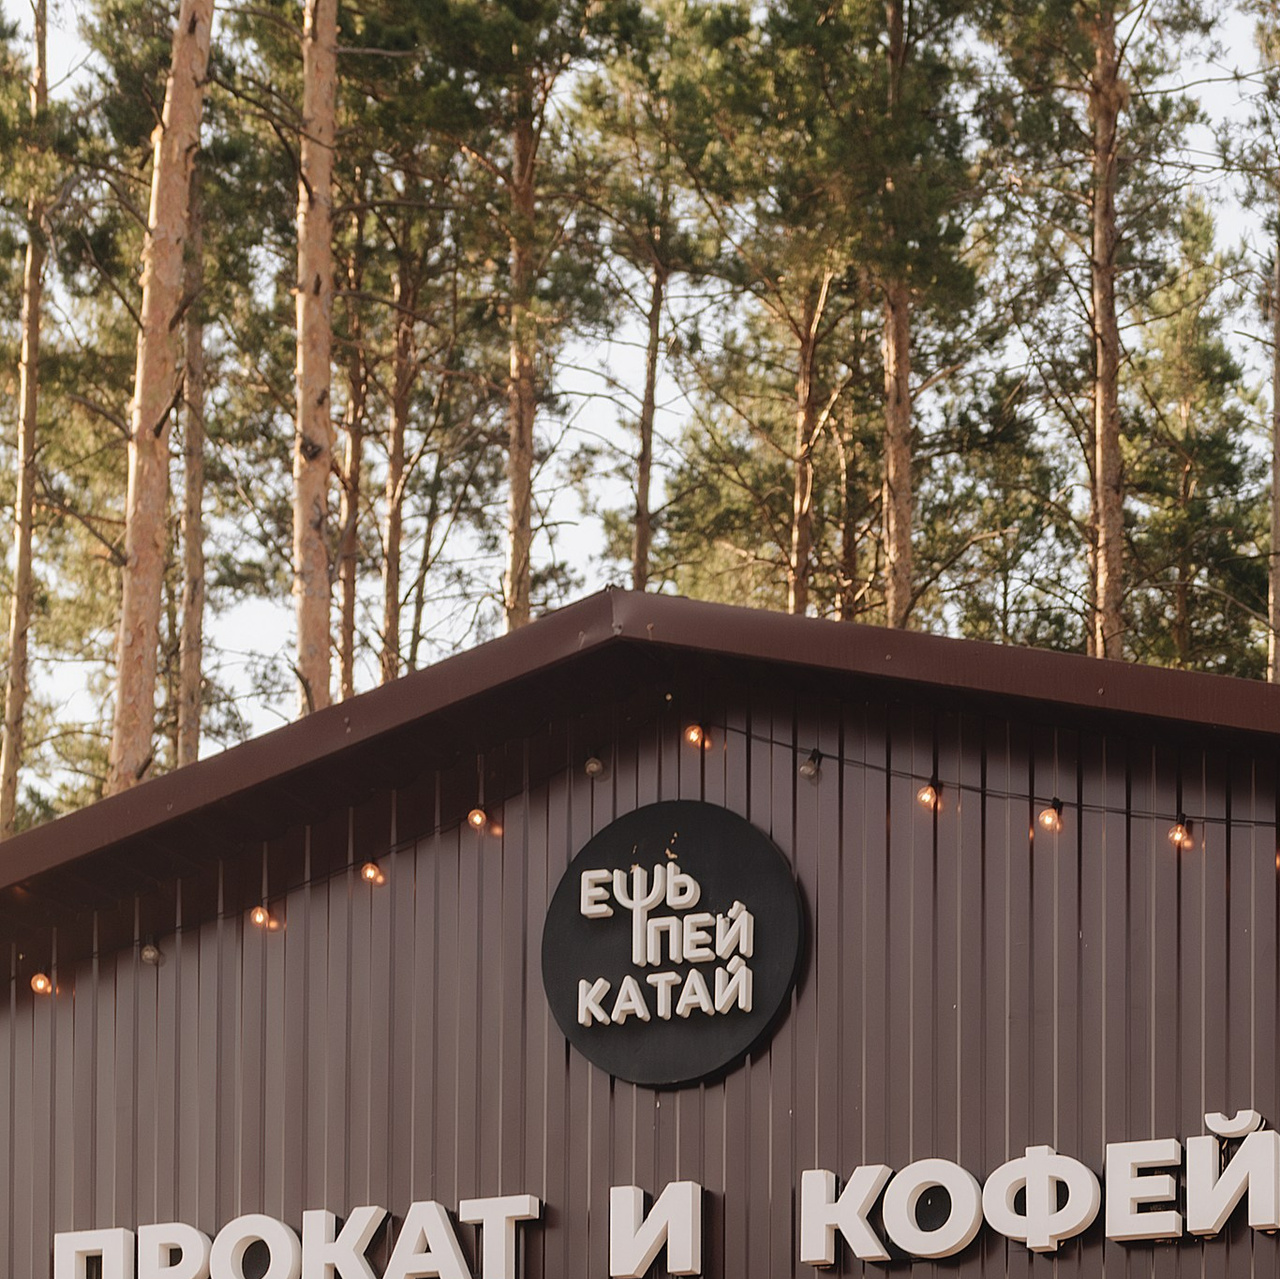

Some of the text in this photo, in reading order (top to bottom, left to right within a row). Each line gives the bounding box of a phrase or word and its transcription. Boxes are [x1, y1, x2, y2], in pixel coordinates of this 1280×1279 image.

[647, 900, 754, 966] ПЕЙ
[578, 955, 752, 1027] КАТАЙ
[610, 1181, 701, 1279] И
